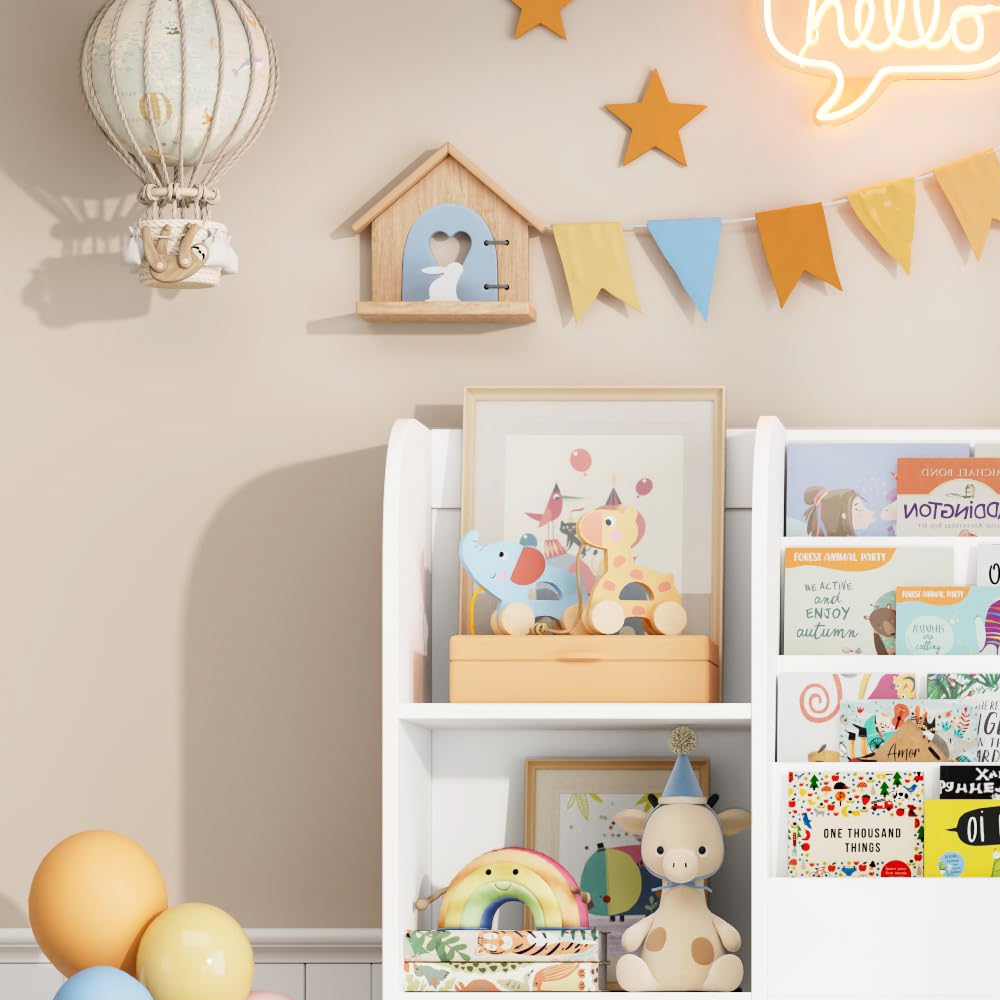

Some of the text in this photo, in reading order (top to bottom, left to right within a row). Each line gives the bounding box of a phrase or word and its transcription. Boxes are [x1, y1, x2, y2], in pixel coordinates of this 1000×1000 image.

[793, 552, 887, 562] FOREST ANIMAL PARTY
[989, 563, 1000, 585] O
[804, 580, 853, 592] BE ACTIVE
[814, 592, 841, 605] and
[806, 606, 850, 620] ENJOY
[796, 622, 859, 639] autumn
[887, 744, 920, 761] Amor
[823, 828, 901, 838] ONE THOUSAND
[845, 842, 881, 852] THINGS
